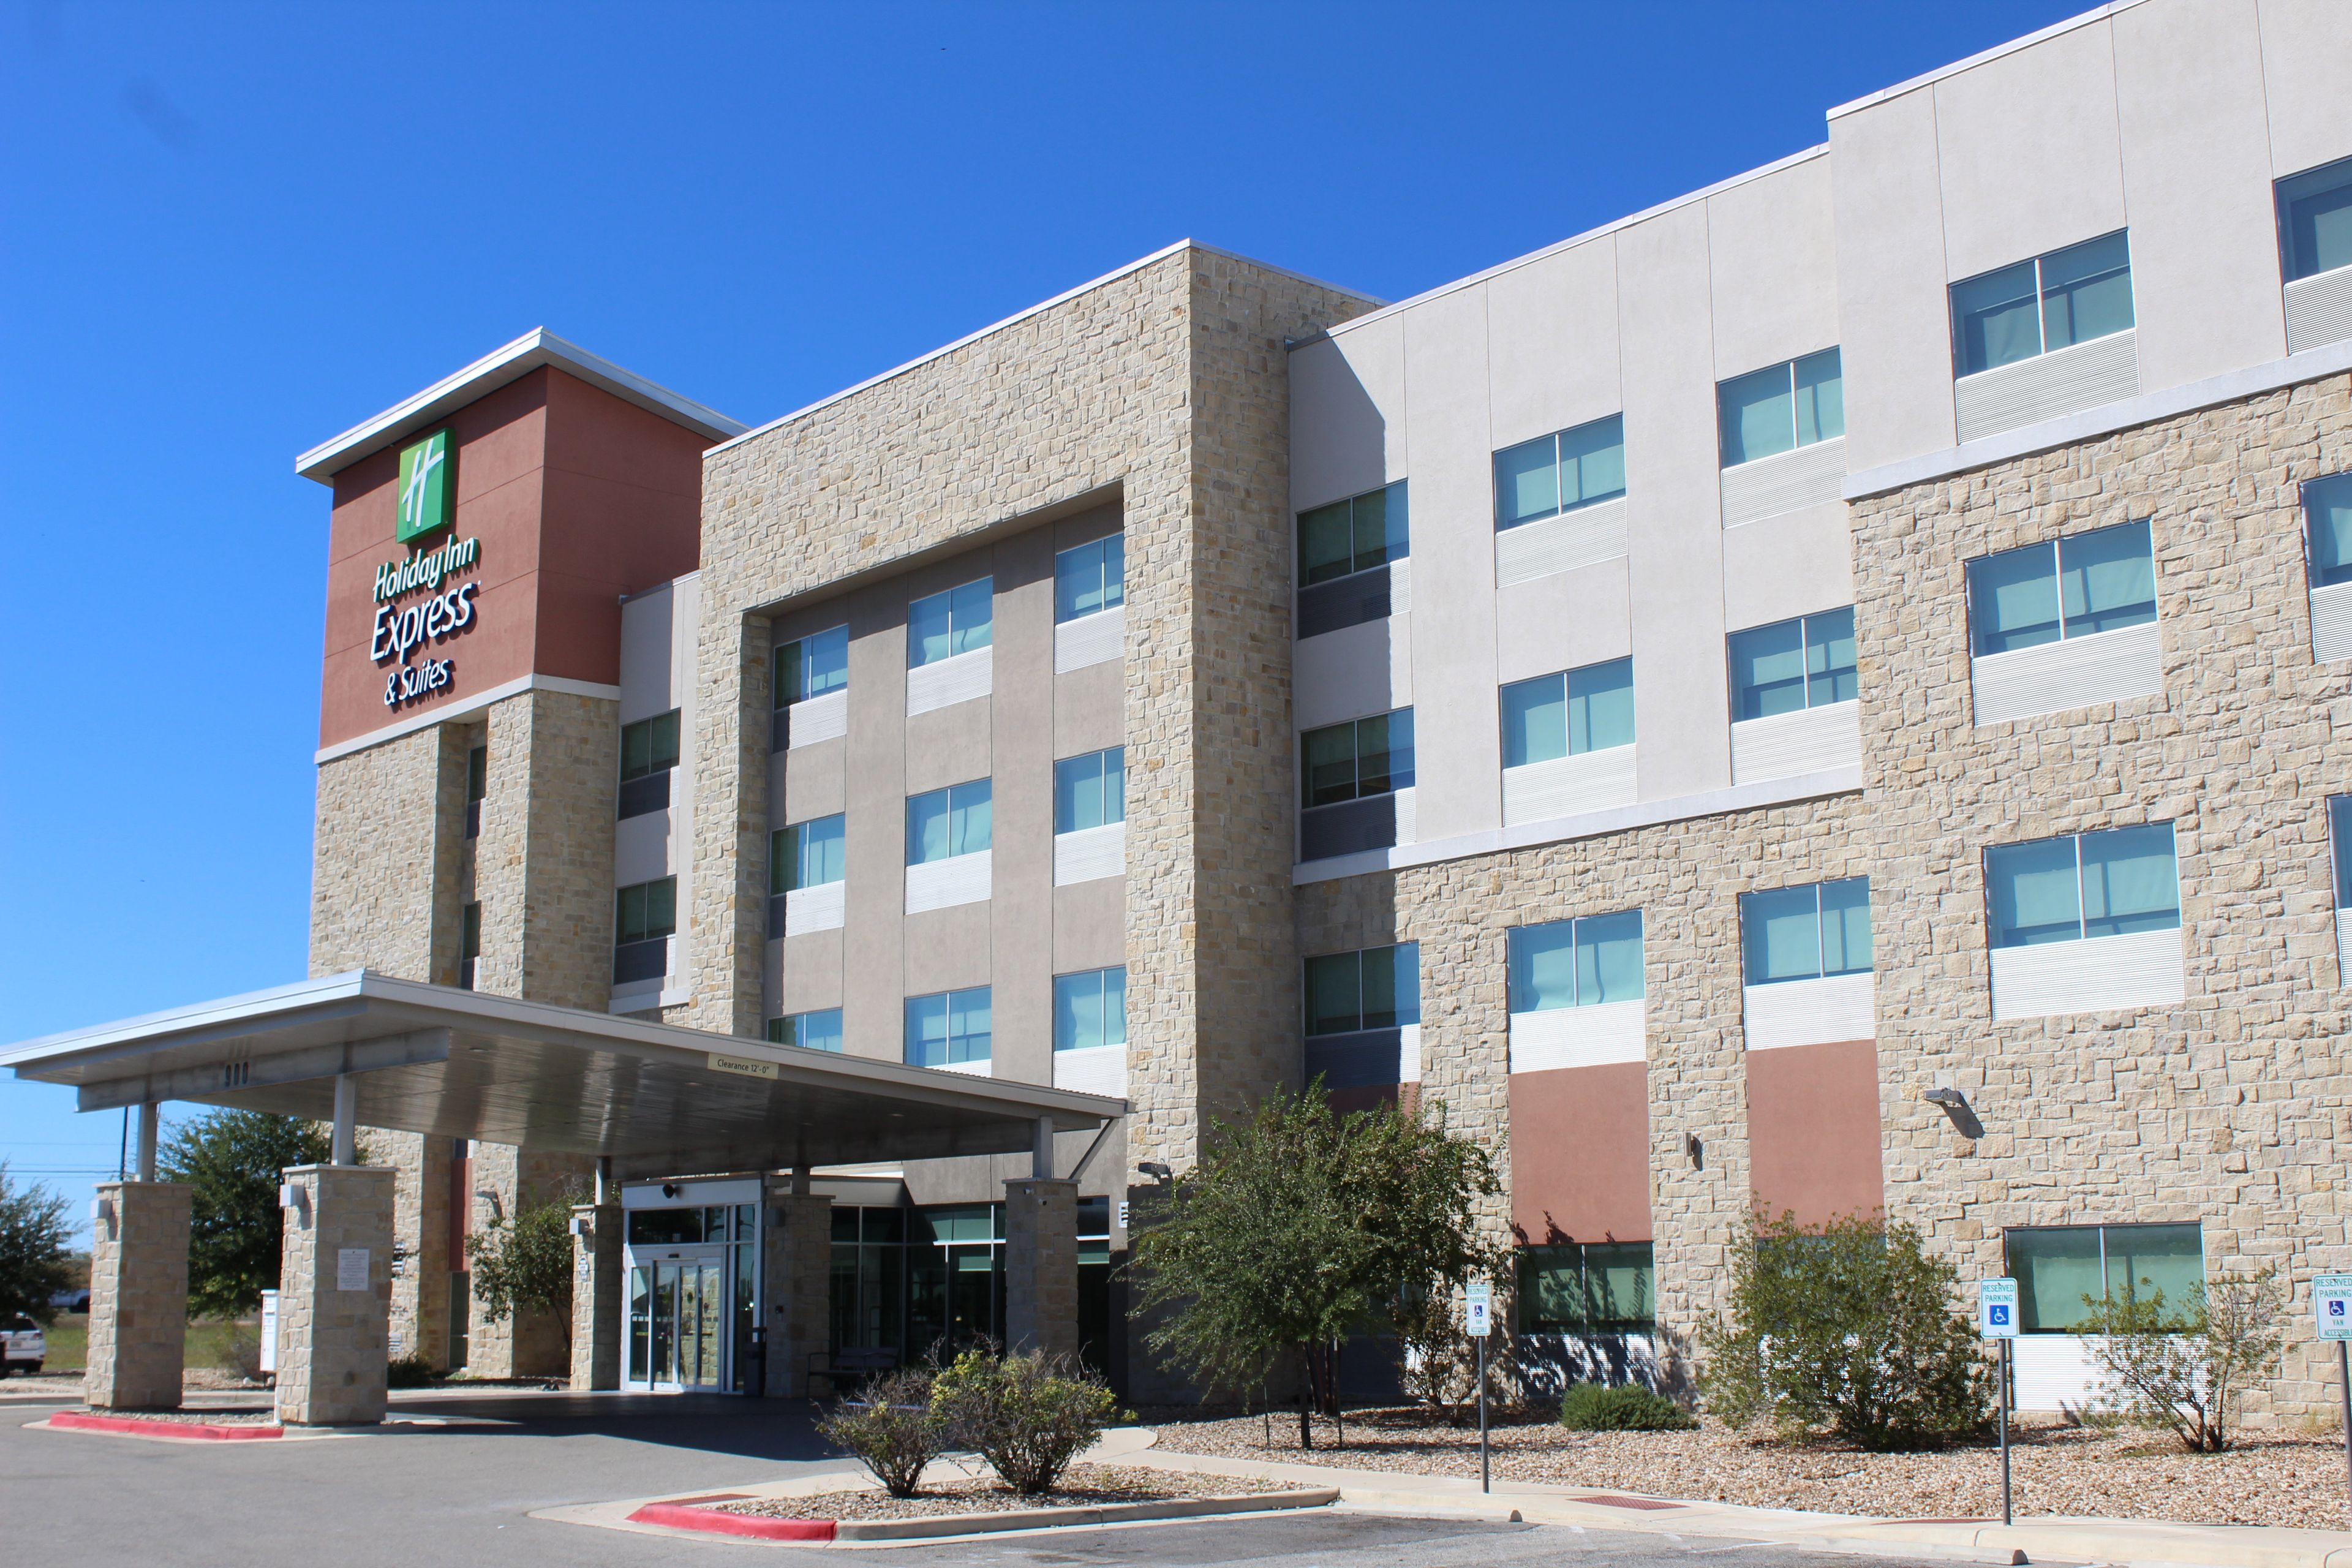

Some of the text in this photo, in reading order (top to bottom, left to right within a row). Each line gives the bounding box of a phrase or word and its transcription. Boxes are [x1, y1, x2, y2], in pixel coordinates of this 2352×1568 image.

[372, 533, 481, 603] Holiday Inn
[370, 582, 474, 665] Express
[384, 658, 450, 706] & Suites
[225, 1061, 249, 1088] 900
[717, 1058, 749, 1071] Clearance
[1982, 1284, 2015, 1292] RESERVED
[2316, 1278, 2352, 1287] RESERVED
[2318, 1289, 2352, 1298] PARKING
